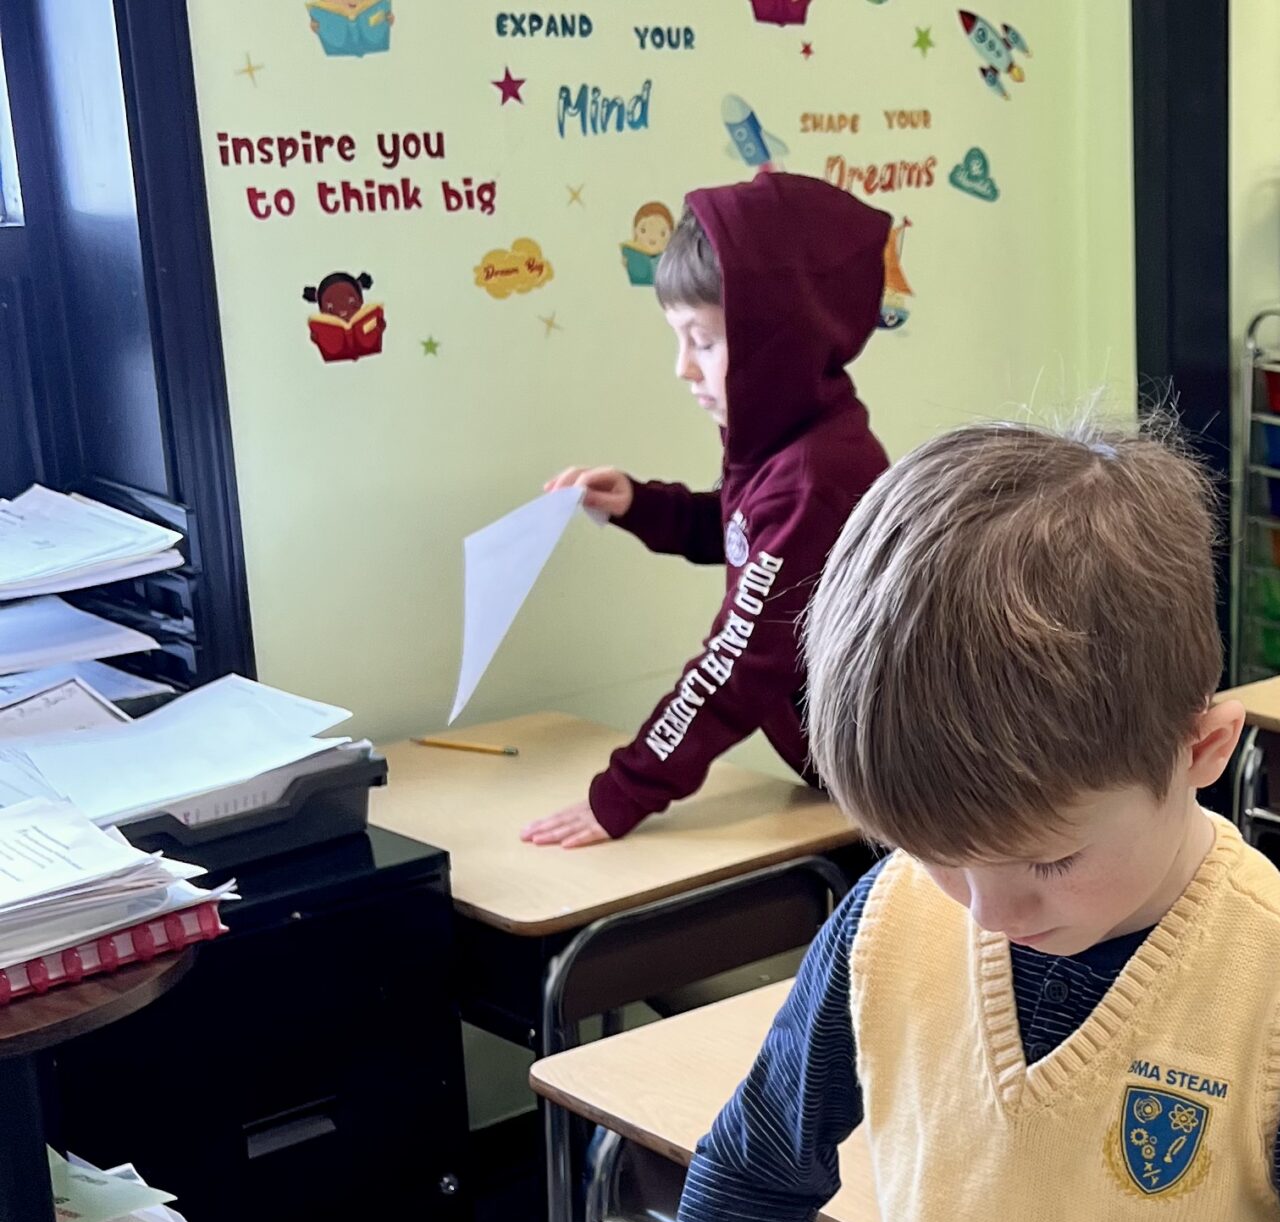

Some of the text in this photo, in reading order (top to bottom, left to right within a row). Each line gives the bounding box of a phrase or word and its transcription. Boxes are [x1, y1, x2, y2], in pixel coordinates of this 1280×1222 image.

[496, 13, 695, 50] EXPAND YOUR
[557, 78, 652, 138] Mind
[800, 109, 931, 134] SHAPE YOUR
[216, 130, 445, 168] inspire you
[246, 177, 496, 220] to think big
[645, 551, 784, 762] POLO RALPH LAUREN
[1166, 1069, 1228, 1098] STEAM
